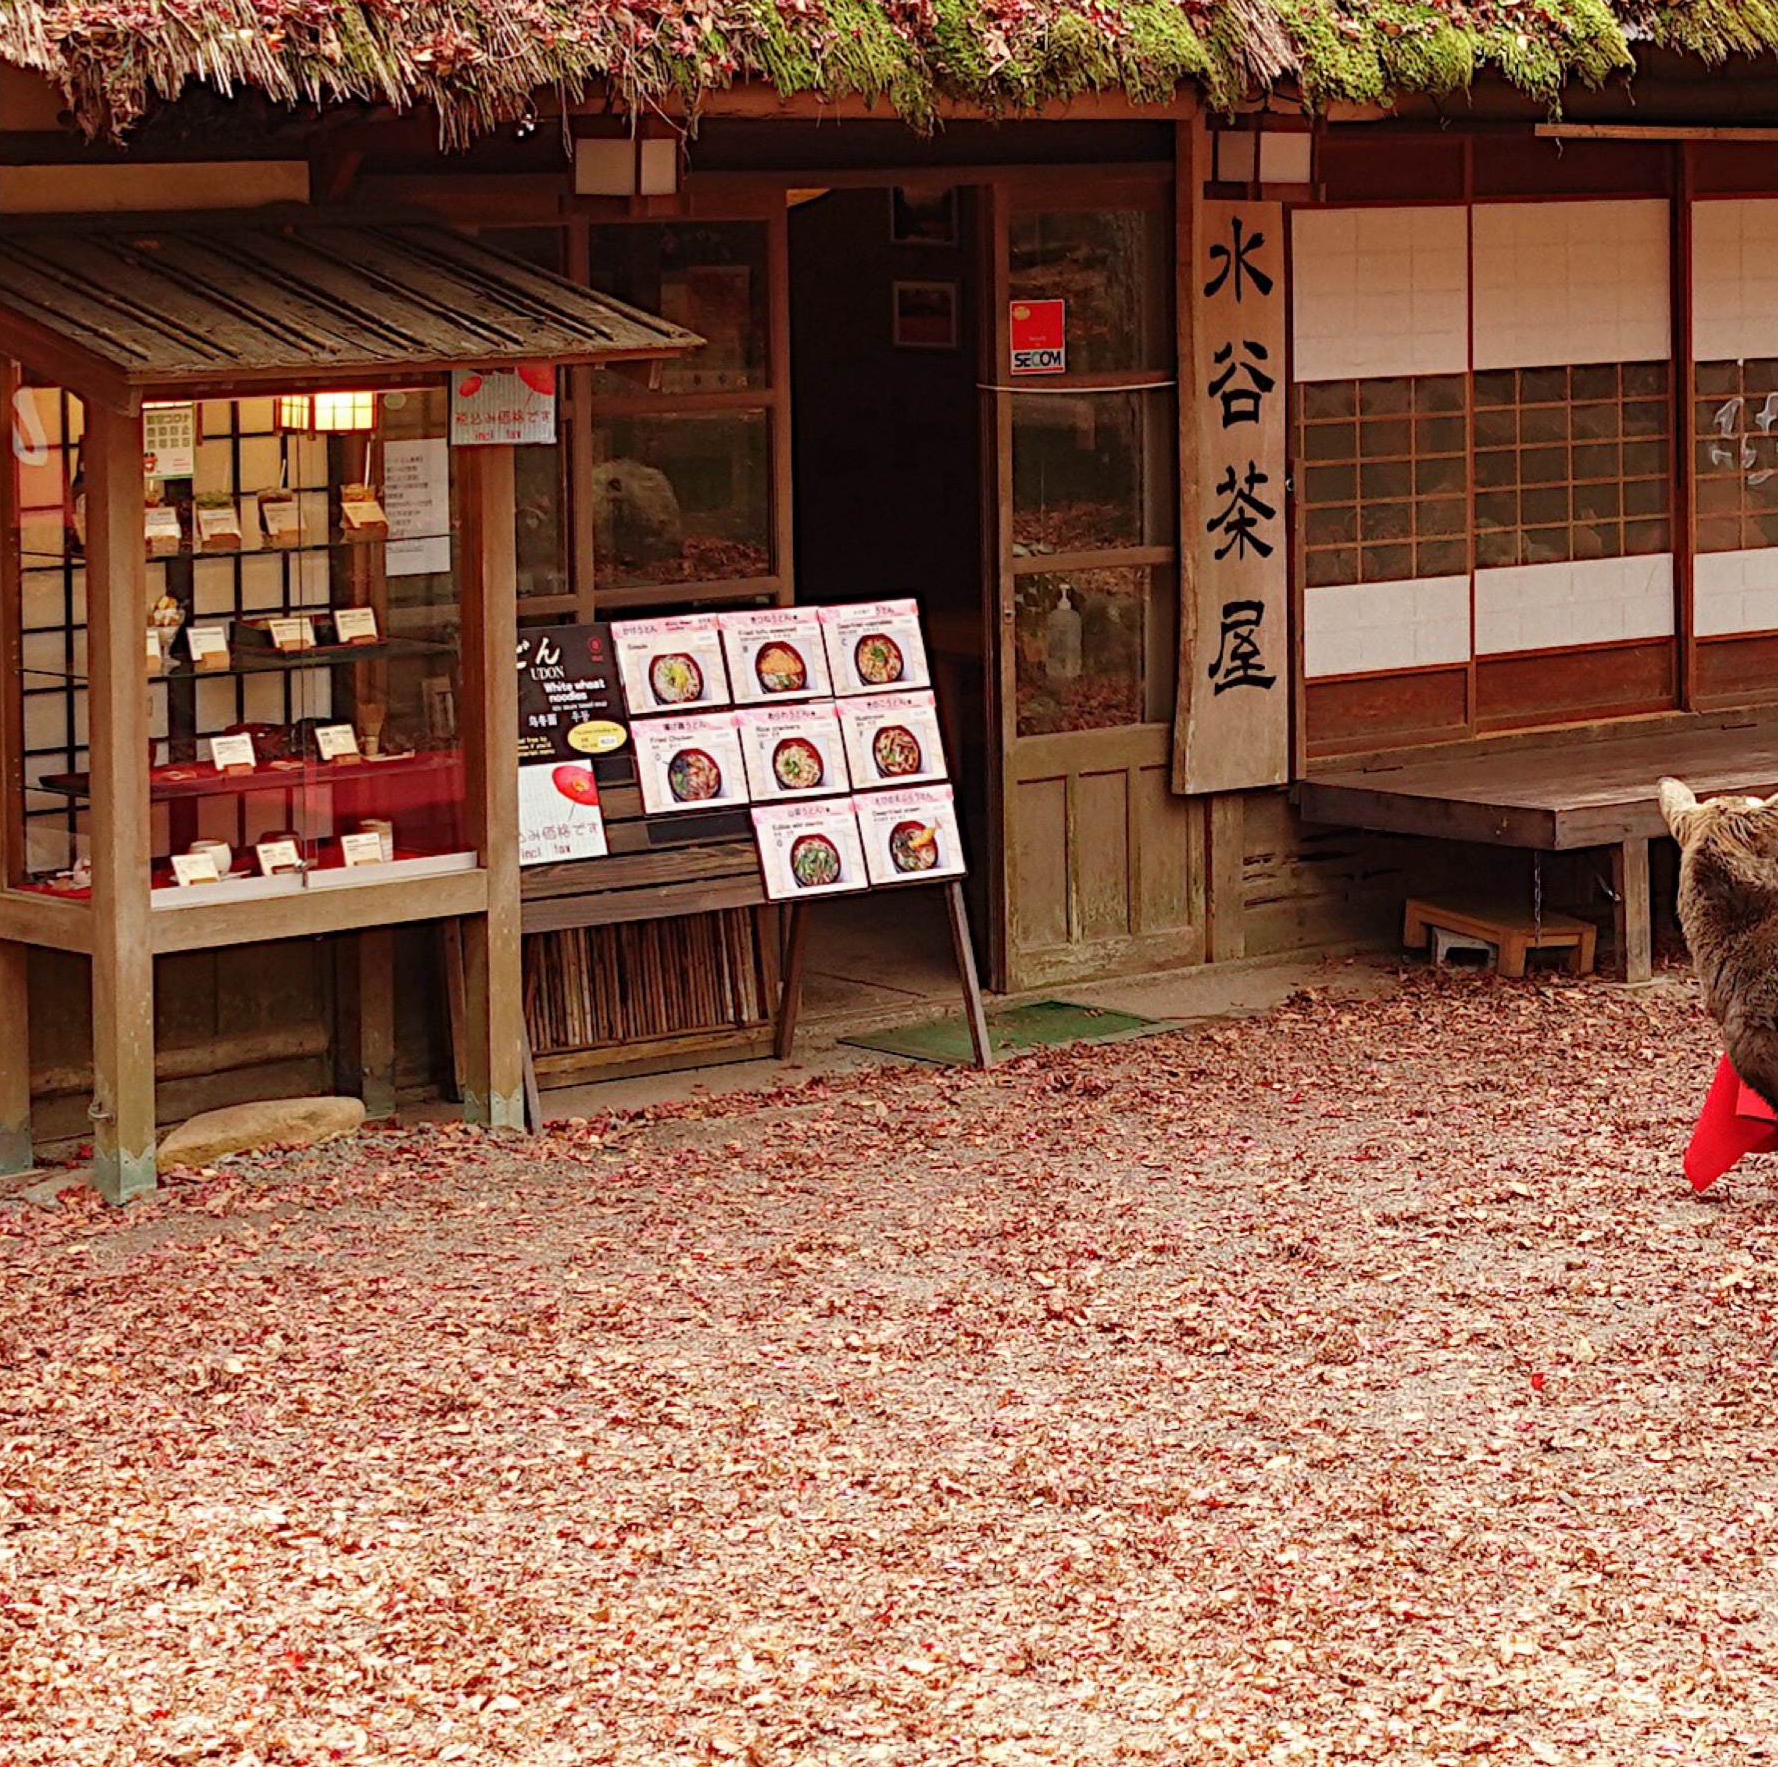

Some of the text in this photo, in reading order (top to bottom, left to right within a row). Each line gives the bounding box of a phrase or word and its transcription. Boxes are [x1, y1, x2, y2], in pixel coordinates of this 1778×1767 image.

[1015, 351, 1061, 367] SECOM
[1203, 215, 1276, 696] 水谷茶屋
[530, 666, 565, 680] UDON
